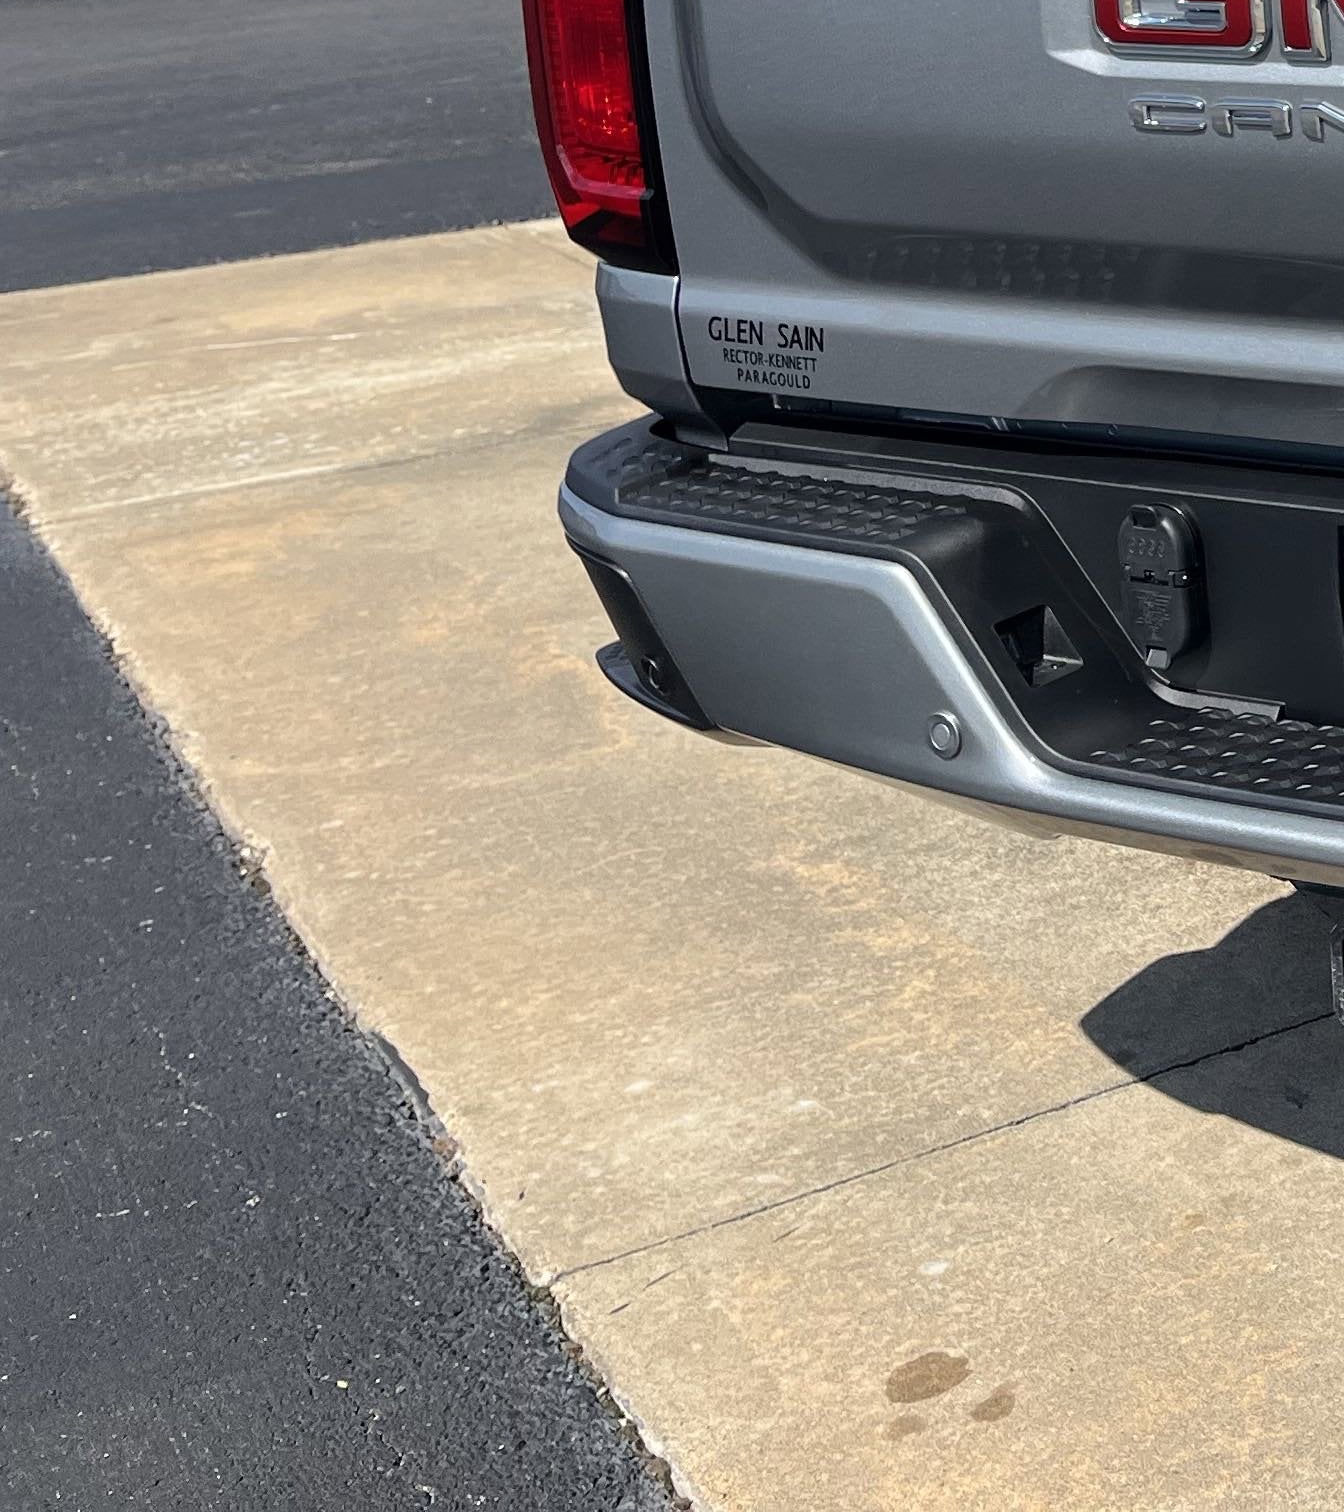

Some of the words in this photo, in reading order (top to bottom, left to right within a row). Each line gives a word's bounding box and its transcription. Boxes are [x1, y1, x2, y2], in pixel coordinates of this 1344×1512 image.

[708, 316, 763, 346] GLEN
[777, 323, 824, 352] SAIN
[723, 348, 818, 372] RECTOR-KENNETT
[737, 368, 812, 389] PARAGOULD
